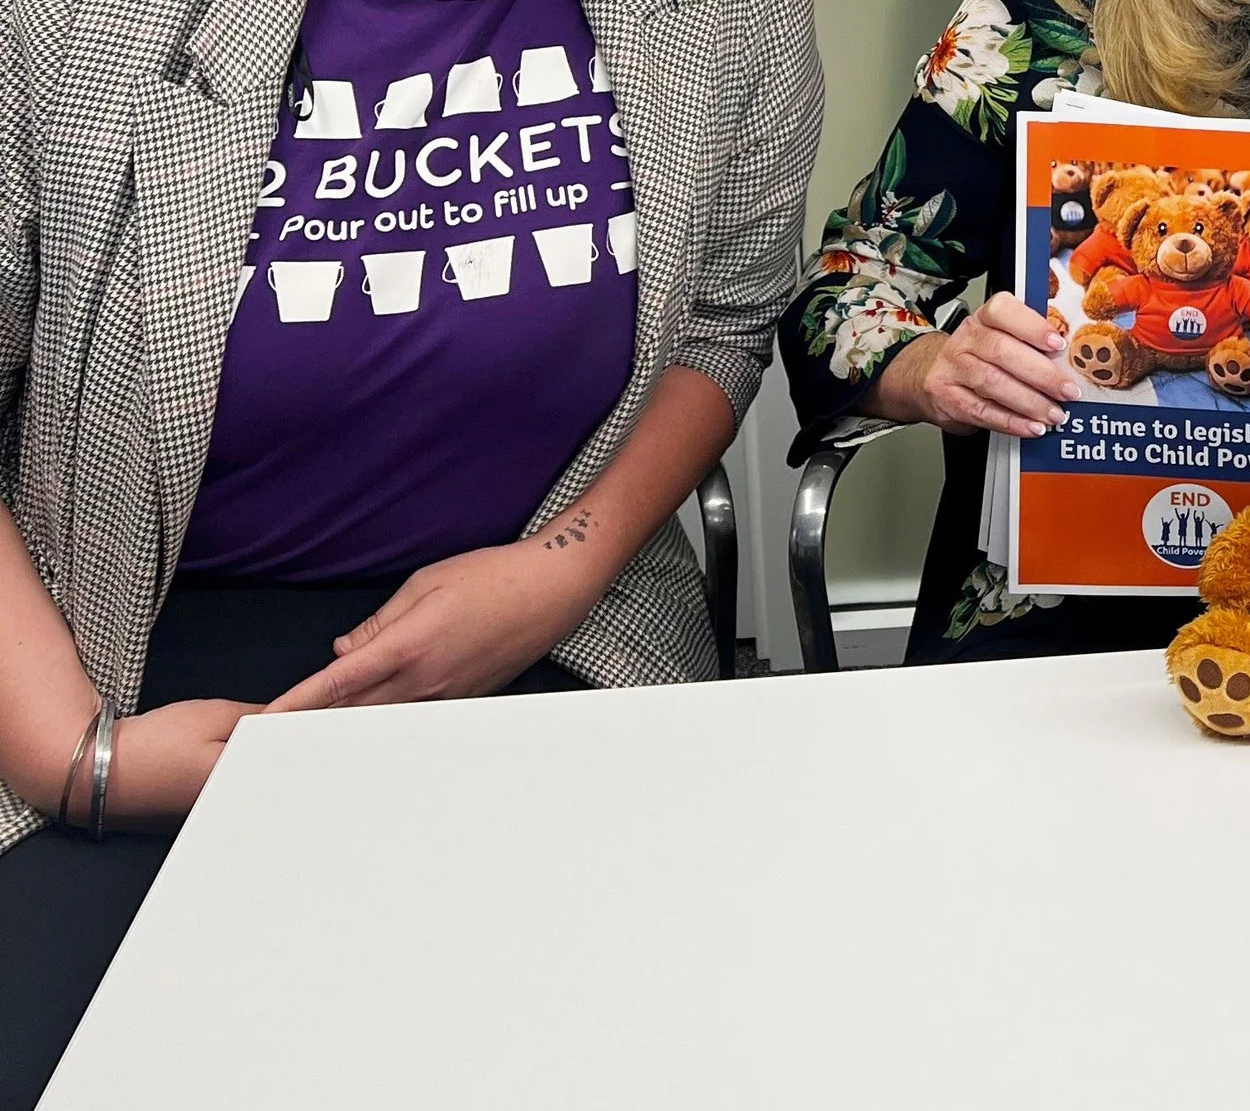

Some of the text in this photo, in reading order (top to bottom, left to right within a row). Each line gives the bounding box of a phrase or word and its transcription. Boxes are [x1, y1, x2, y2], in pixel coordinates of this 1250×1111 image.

[315, 112, 629, 200] BUCKETS
[279, 215, 365, 241] Pour
[374, 203, 435, 233] out
[443, 199, 483, 226] to
[546, 182, 589, 210] up
[1090, 415, 1146, 437] time
[1152, 420, 1178, 439] to
[1060, 439, 1106, 461] End
[1112, 442, 1138, 462] to
[1145, 443, 1210, 466] Child
[1170, 491, 1211, 507] END
[1156, 547, 1206, 556] Child Pove
